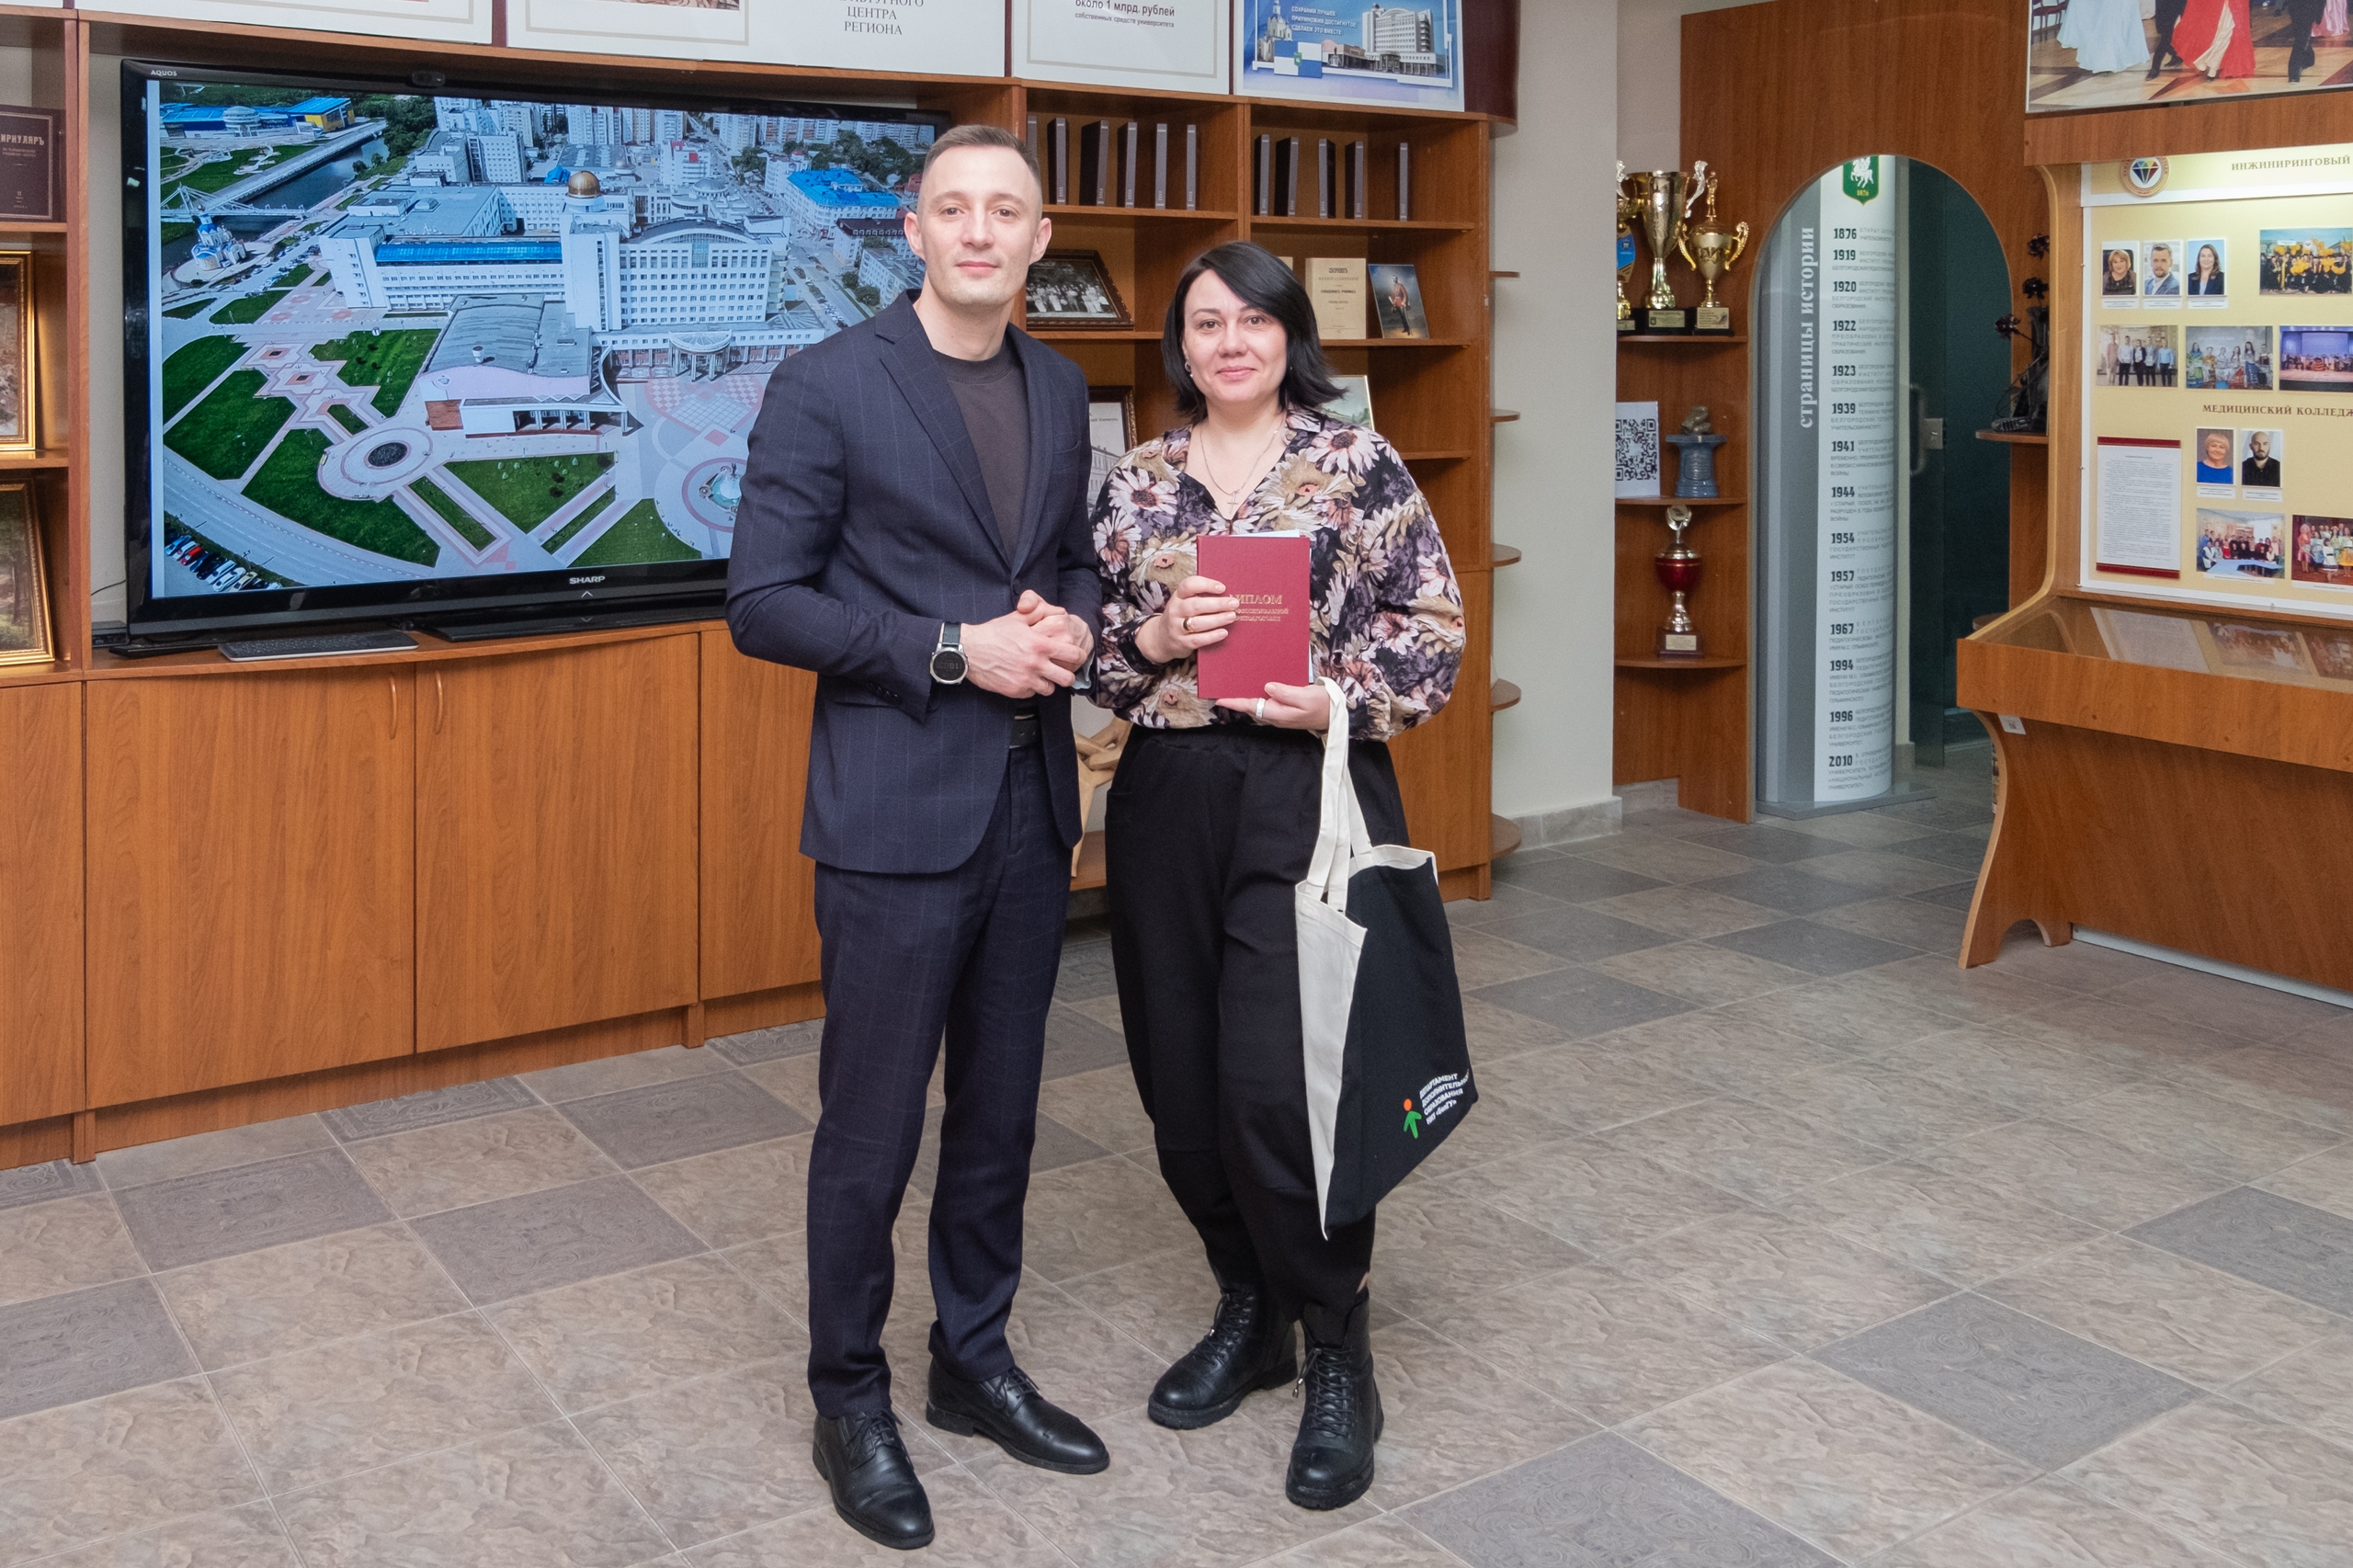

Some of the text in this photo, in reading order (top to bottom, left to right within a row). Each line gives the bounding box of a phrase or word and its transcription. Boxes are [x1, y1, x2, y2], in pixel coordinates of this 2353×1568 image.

[847, 6, 897, 19] ЦЕНТРА
[1107, 0, 1110, 10] 1
[1114, 3, 1141, 14] млрд.
[1142, 4, 1175, 17] рублей
[1075, 12, 1112, 21] собственных
[1136, 19, 1175, 28] университета
[845, 21, 903, 35] РЕГИОНА
[151, 69, 177, 77] AQUOS
[2231, 154, 2351, 171] ИНЖИНИРИНГОВЫЙ
[1833, 228, 1857, 239] 1876
[1833, 249, 1856, 260] 1919
[1833, 281, 1857, 292] 1920
[1800, 227, 1818, 428] страницы истории
[1832, 320, 1857, 331] 1922
[1832, 365, 1856, 376] 1923
[1832, 403, 1856, 414] 1939
[2202, 404, 2353, 417] МЕДИЦИНСКИЙ КОЛЛЕДЖ
[1831, 440, 1855, 452] 1941
[1831, 486, 1855, 497] 1944
[1831, 532, 1855, 544] 1954
[569, 575, 606, 585] SHARP
[1831, 570, 1855, 582] 1957
[1230, 594, 1282, 605] ИПЛОМ
[1830, 623, 1854, 635] 1967
[1830, 659, 1854, 671] 1994
[1829, 710, 1853, 722] 1996
[1828, 755, 1853, 767] 2010
[1424, 1088, 1463, 1116] ОБРАЗОВАНИЯ
